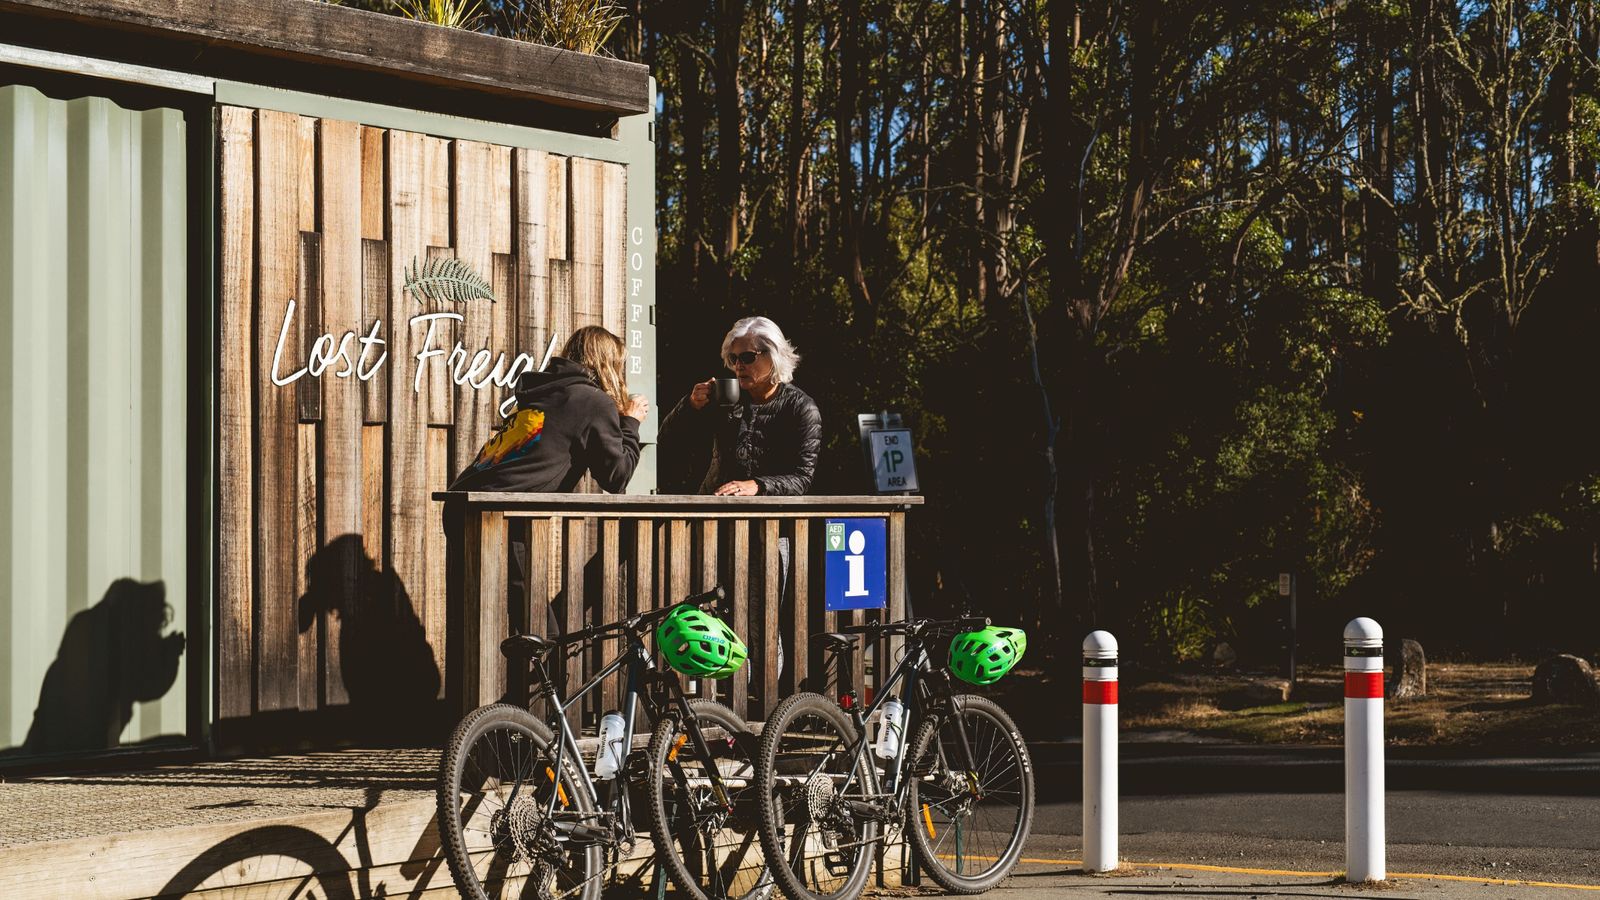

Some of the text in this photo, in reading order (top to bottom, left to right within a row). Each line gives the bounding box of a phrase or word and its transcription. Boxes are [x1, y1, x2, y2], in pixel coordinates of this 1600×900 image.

[630, 227, 643, 374] COFFEE
[271, 299, 558, 419] Lost Freig
[884, 435, 899, 446] END
[882, 450, 904, 473] 1P
[887, 476, 907, 487] AREA
[829, 525, 843, 533] AED
[1011, 731, 1030, 773] MAXXIS
